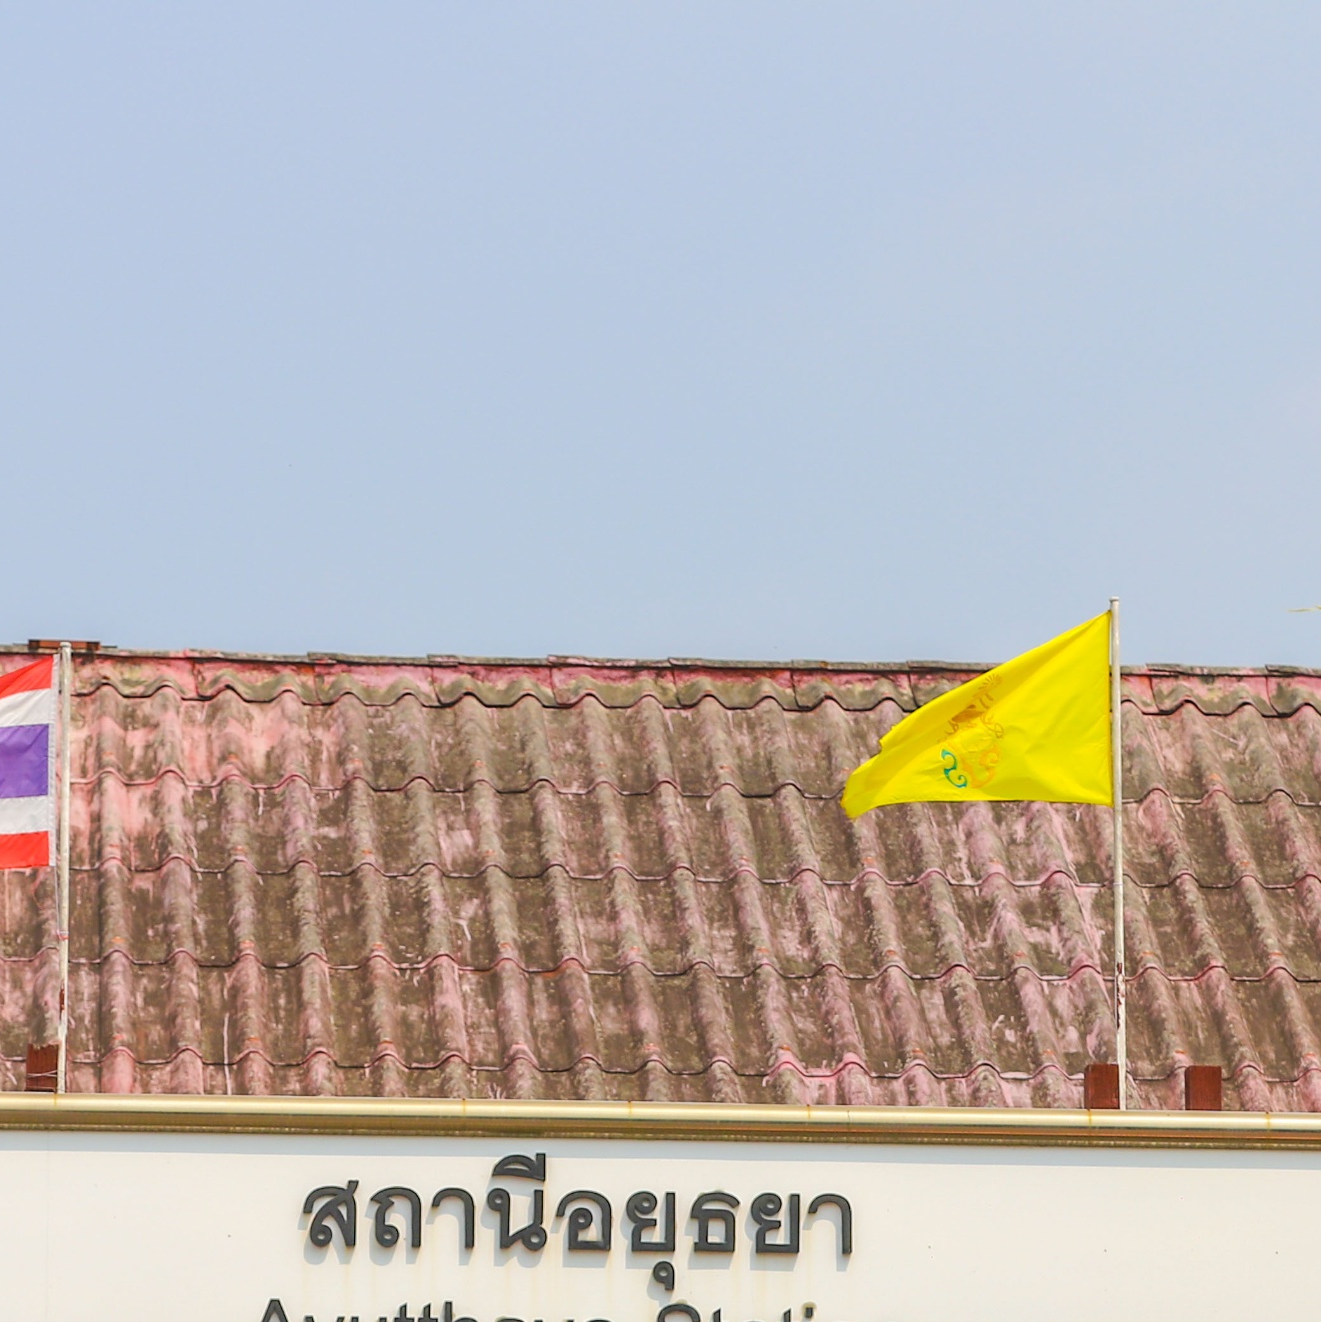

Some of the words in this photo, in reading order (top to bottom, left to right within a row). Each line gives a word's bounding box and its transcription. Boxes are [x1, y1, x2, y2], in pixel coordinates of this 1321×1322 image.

[304, 1154, 853, 1291] สถานีอยุธยา
